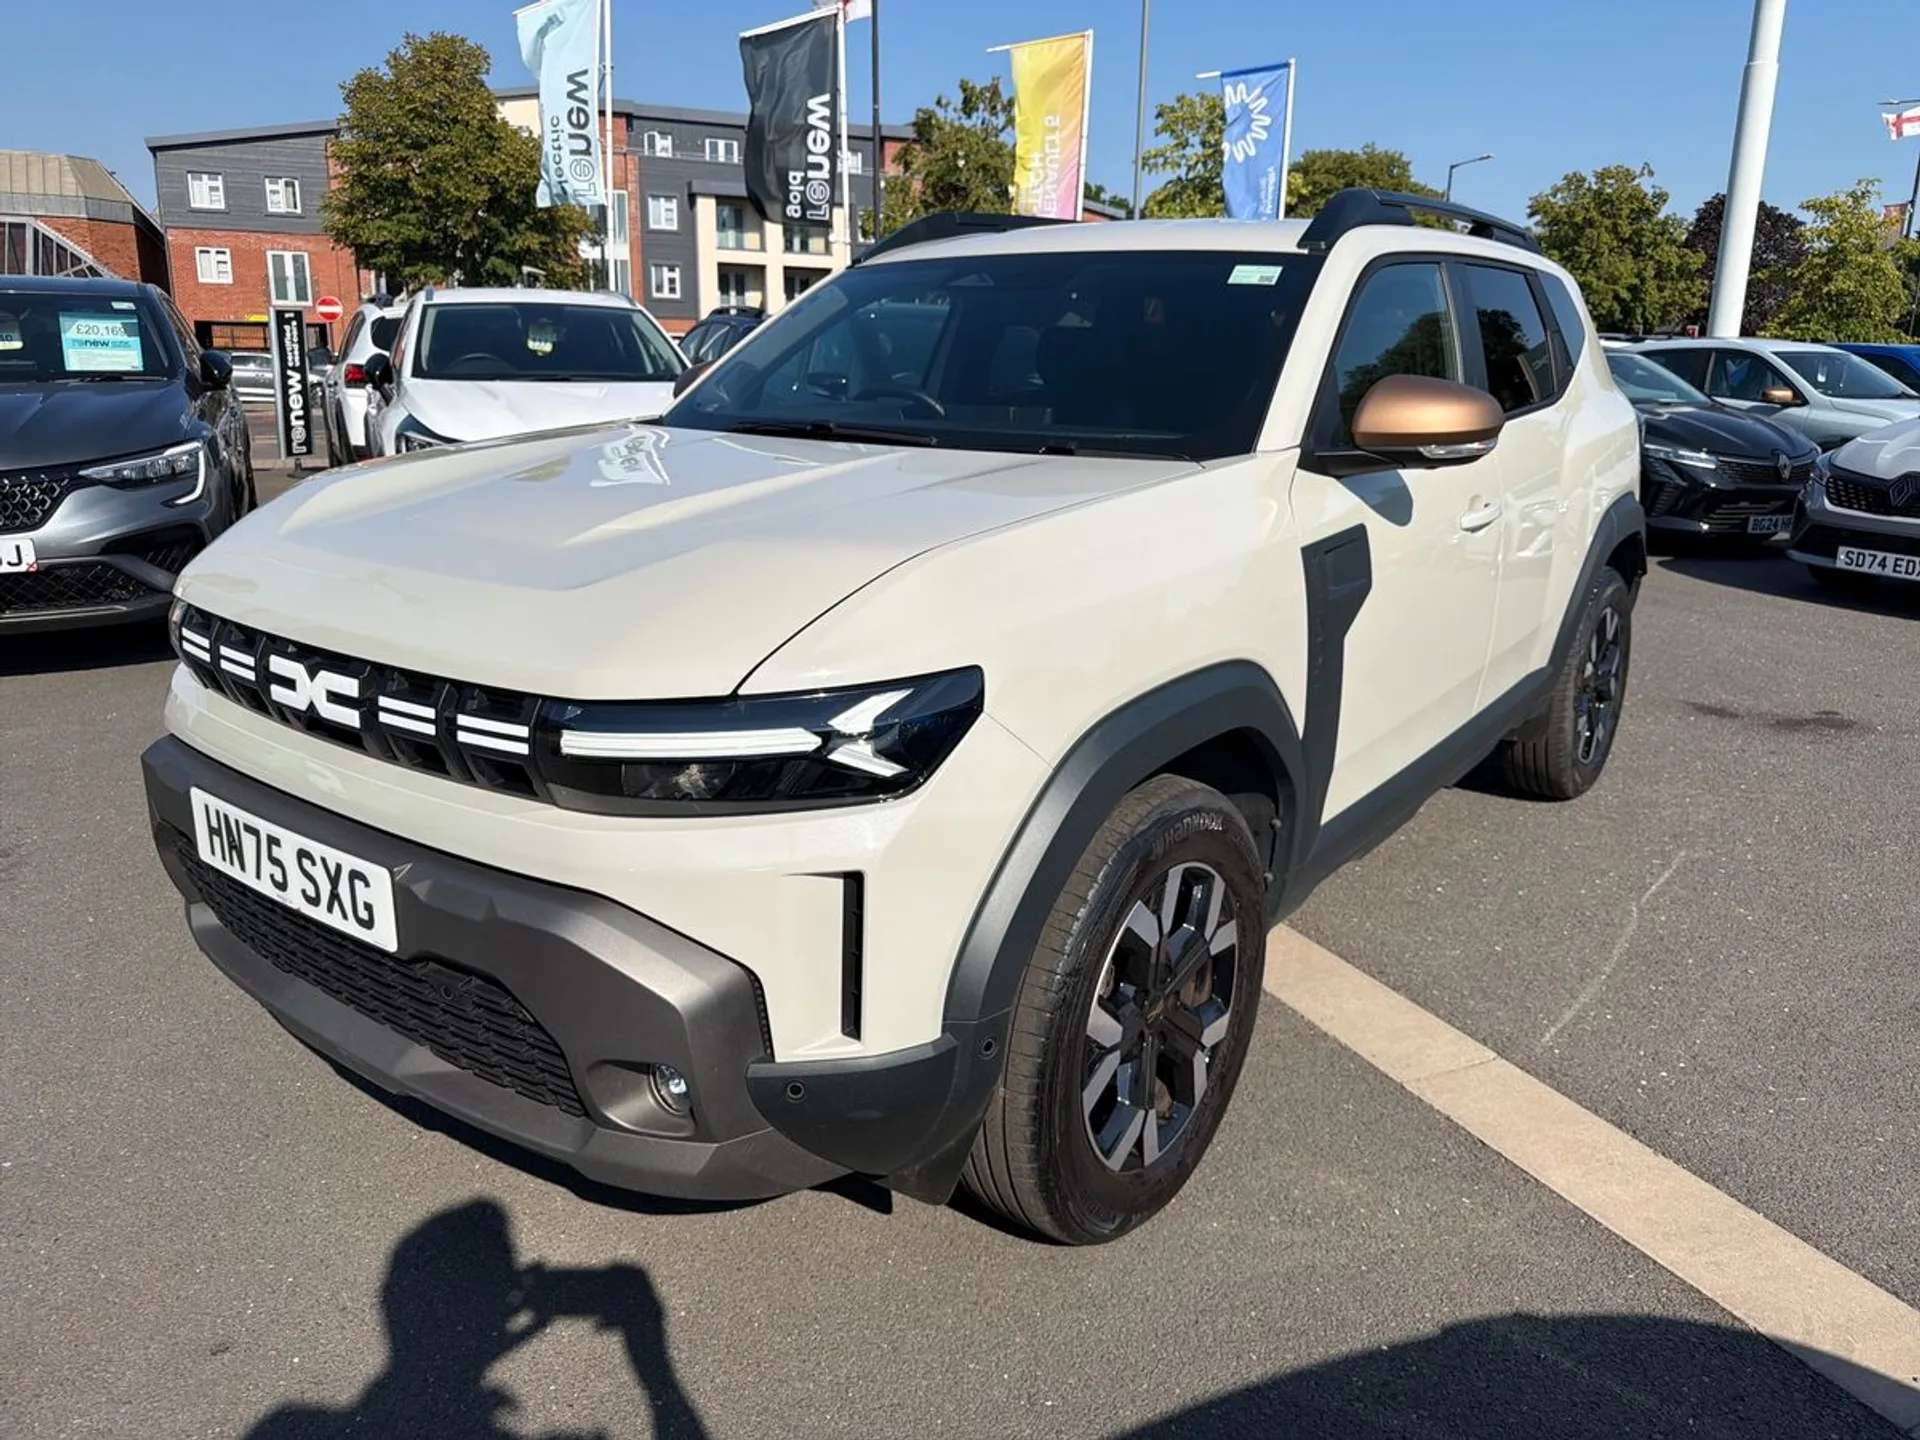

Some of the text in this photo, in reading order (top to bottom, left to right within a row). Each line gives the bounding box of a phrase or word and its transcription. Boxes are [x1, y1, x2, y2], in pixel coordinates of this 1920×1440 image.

[286, 369, 308, 455] renew
[1844, 550, 1888, 572] SD74
[203, 803, 376, 931] HN75 SXG
